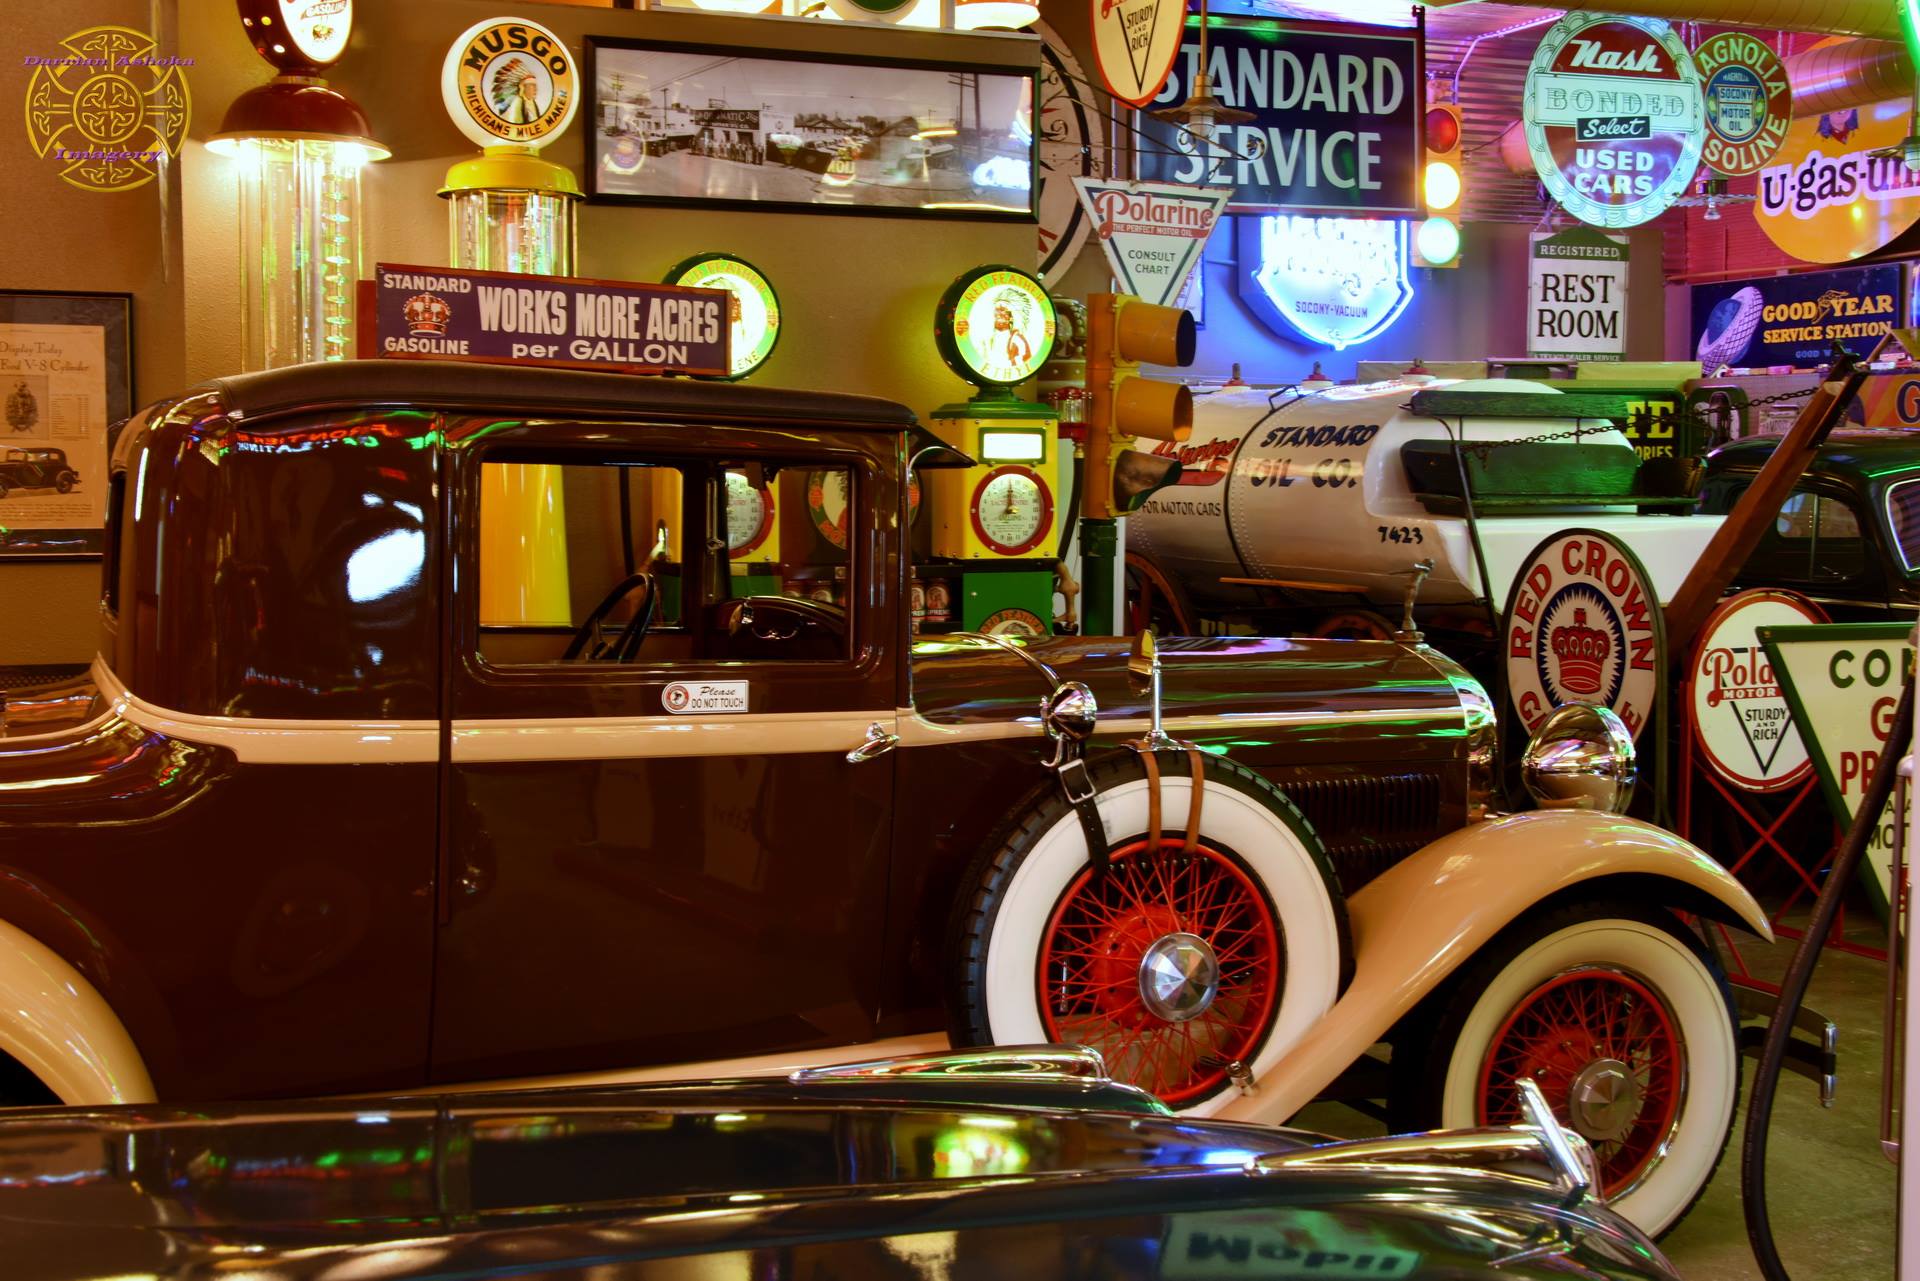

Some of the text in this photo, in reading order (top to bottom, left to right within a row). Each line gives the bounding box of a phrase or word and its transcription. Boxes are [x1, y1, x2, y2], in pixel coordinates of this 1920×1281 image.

[1126, 4, 1154, 29] STURDY
[464, 26, 567, 75] MUSGO
[1131, 32, 1149, 51] RICH
[1569, 40, 1663, 73] Nash
[1545, 87, 1685, 117] BONDED
[1720, 88, 1752, 100] SOCONY
[465, 85, 568, 138] MICHIGANS MILE MAKER
[1721, 106, 1751, 119] MOTOR
[1583, 118, 1646, 138] Select
[1728, 121, 1743, 131] OIL
[1703, 114, 1787, 170] SOLINE
[1174, 123, 1382, 190] SERVICE
[1575, 148, 1655, 172] USED
[1574, 172, 1654, 195] CARS
[1094, 190, 1214, 239] Polarine
[1127, 225, 1154, 234] PERFECT
[1156, 227, 1180, 235] MOTOR
[1181, 229, 1193, 237] OIL
[1128, 249, 1177, 262] CONSULT
[1540, 245, 1620, 258] REGISTERED
[1135, 263, 1170, 275] CHART
[384, 273, 472, 293] STANDARD
[1541, 273, 1615, 303] REST
[476, 285, 719, 344] WORKS MORE ACRES
[1295, 301, 1368, 318] SOCONY-VACUUM
[1536, 308, 1619, 339] ROOM
[1763, 321, 1892, 344] SERVICE STATION
[384, 336, 470, 355] GASOLINE
[512, 339, 688, 365] per GALLON
[1260, 424, 1380, 448] STANDARD
[1251, 458, 1297, 488] OIL
[1160, 502, 1195, 515] MOTOR
[1196, 502, 1221, 516] CARS
[1377, 526, 1423, 544] 7423
[1510, 540, 1655, 671] RED CROWN
[700, 686, 736, 696] Please
[1723, 688, 1777, 699] MOTOR
[691, 698, 744, 708] DO NOT TOUCH
[1745, 707, 1787, 721] STURDY
[1752, 728, 1778, 740] RICH
